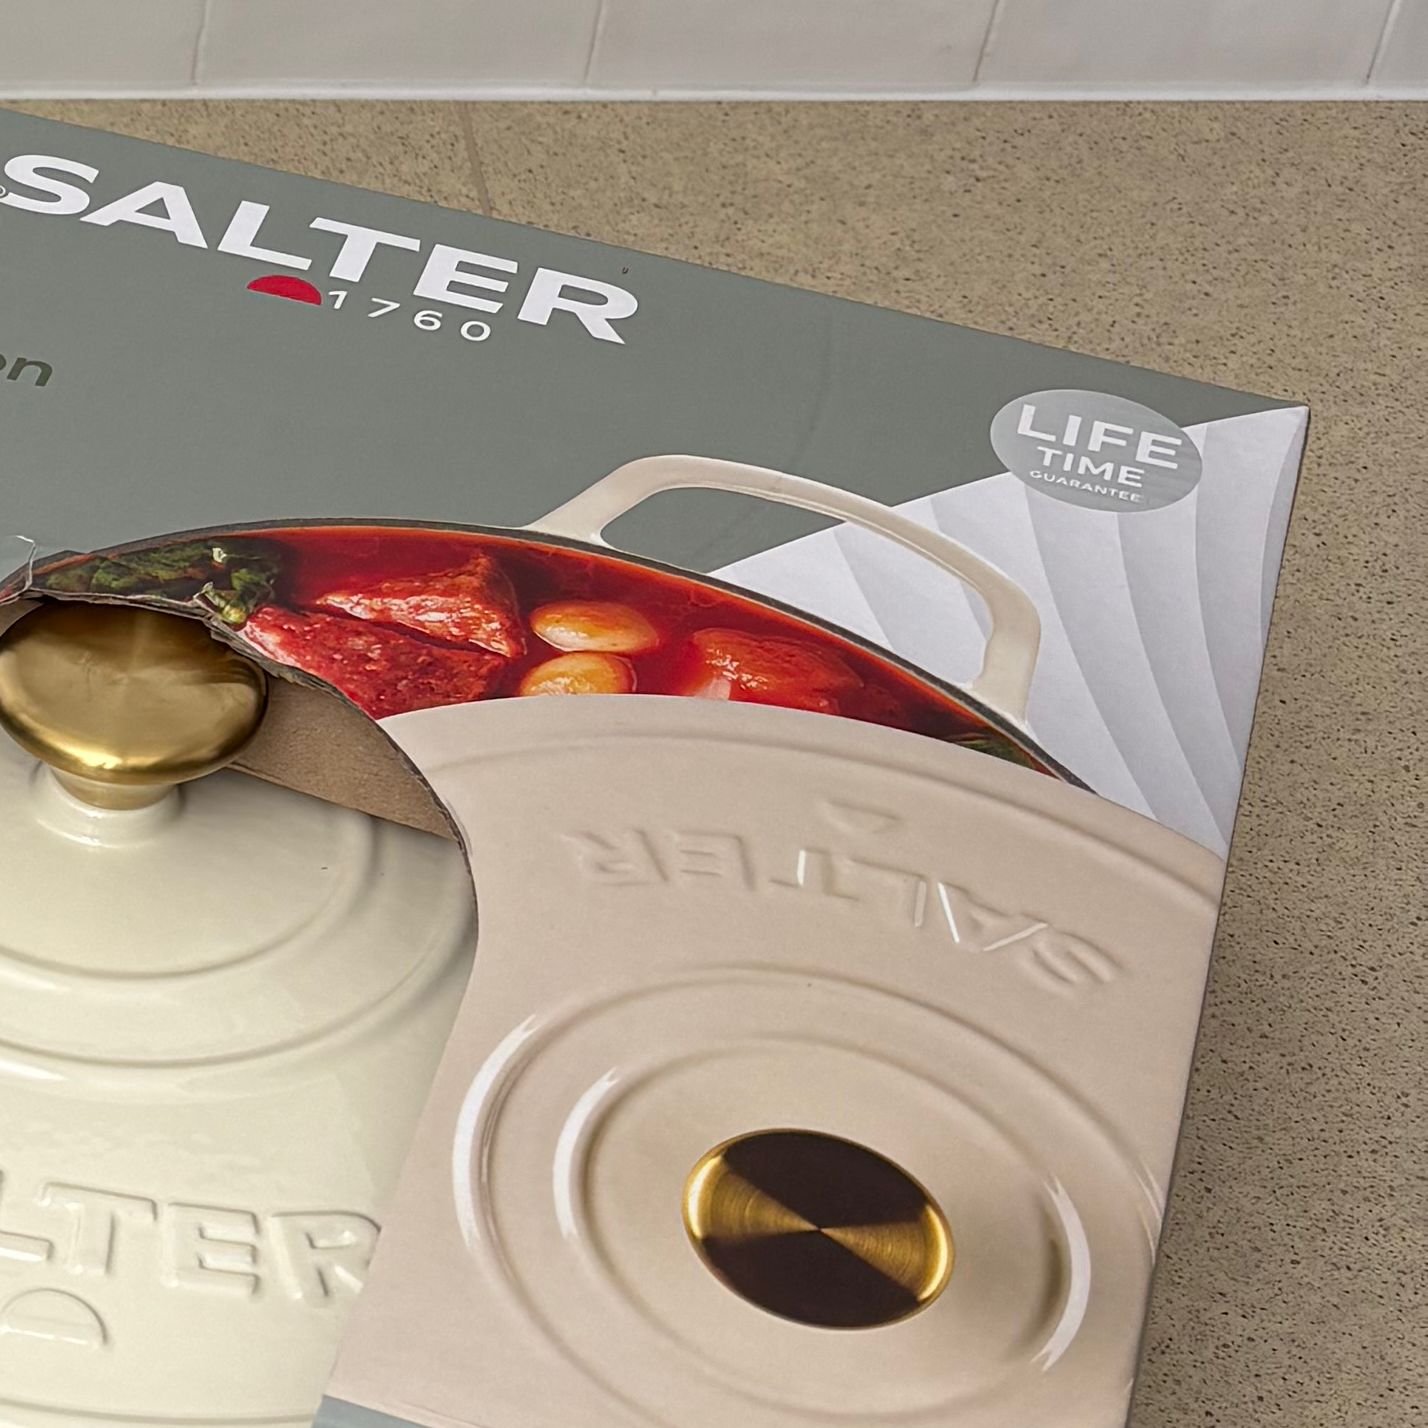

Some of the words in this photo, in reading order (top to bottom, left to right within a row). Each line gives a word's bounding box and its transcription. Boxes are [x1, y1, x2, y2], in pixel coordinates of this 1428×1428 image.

[5, 153, 639, 345] SALTER
[326, 288, 493, 343] 1760
[1017, 403, 1183, 470] LIFE
[1029, 469, 1144, 503] GUARANTEE
[1036, 446, 1146, 488] TIME
